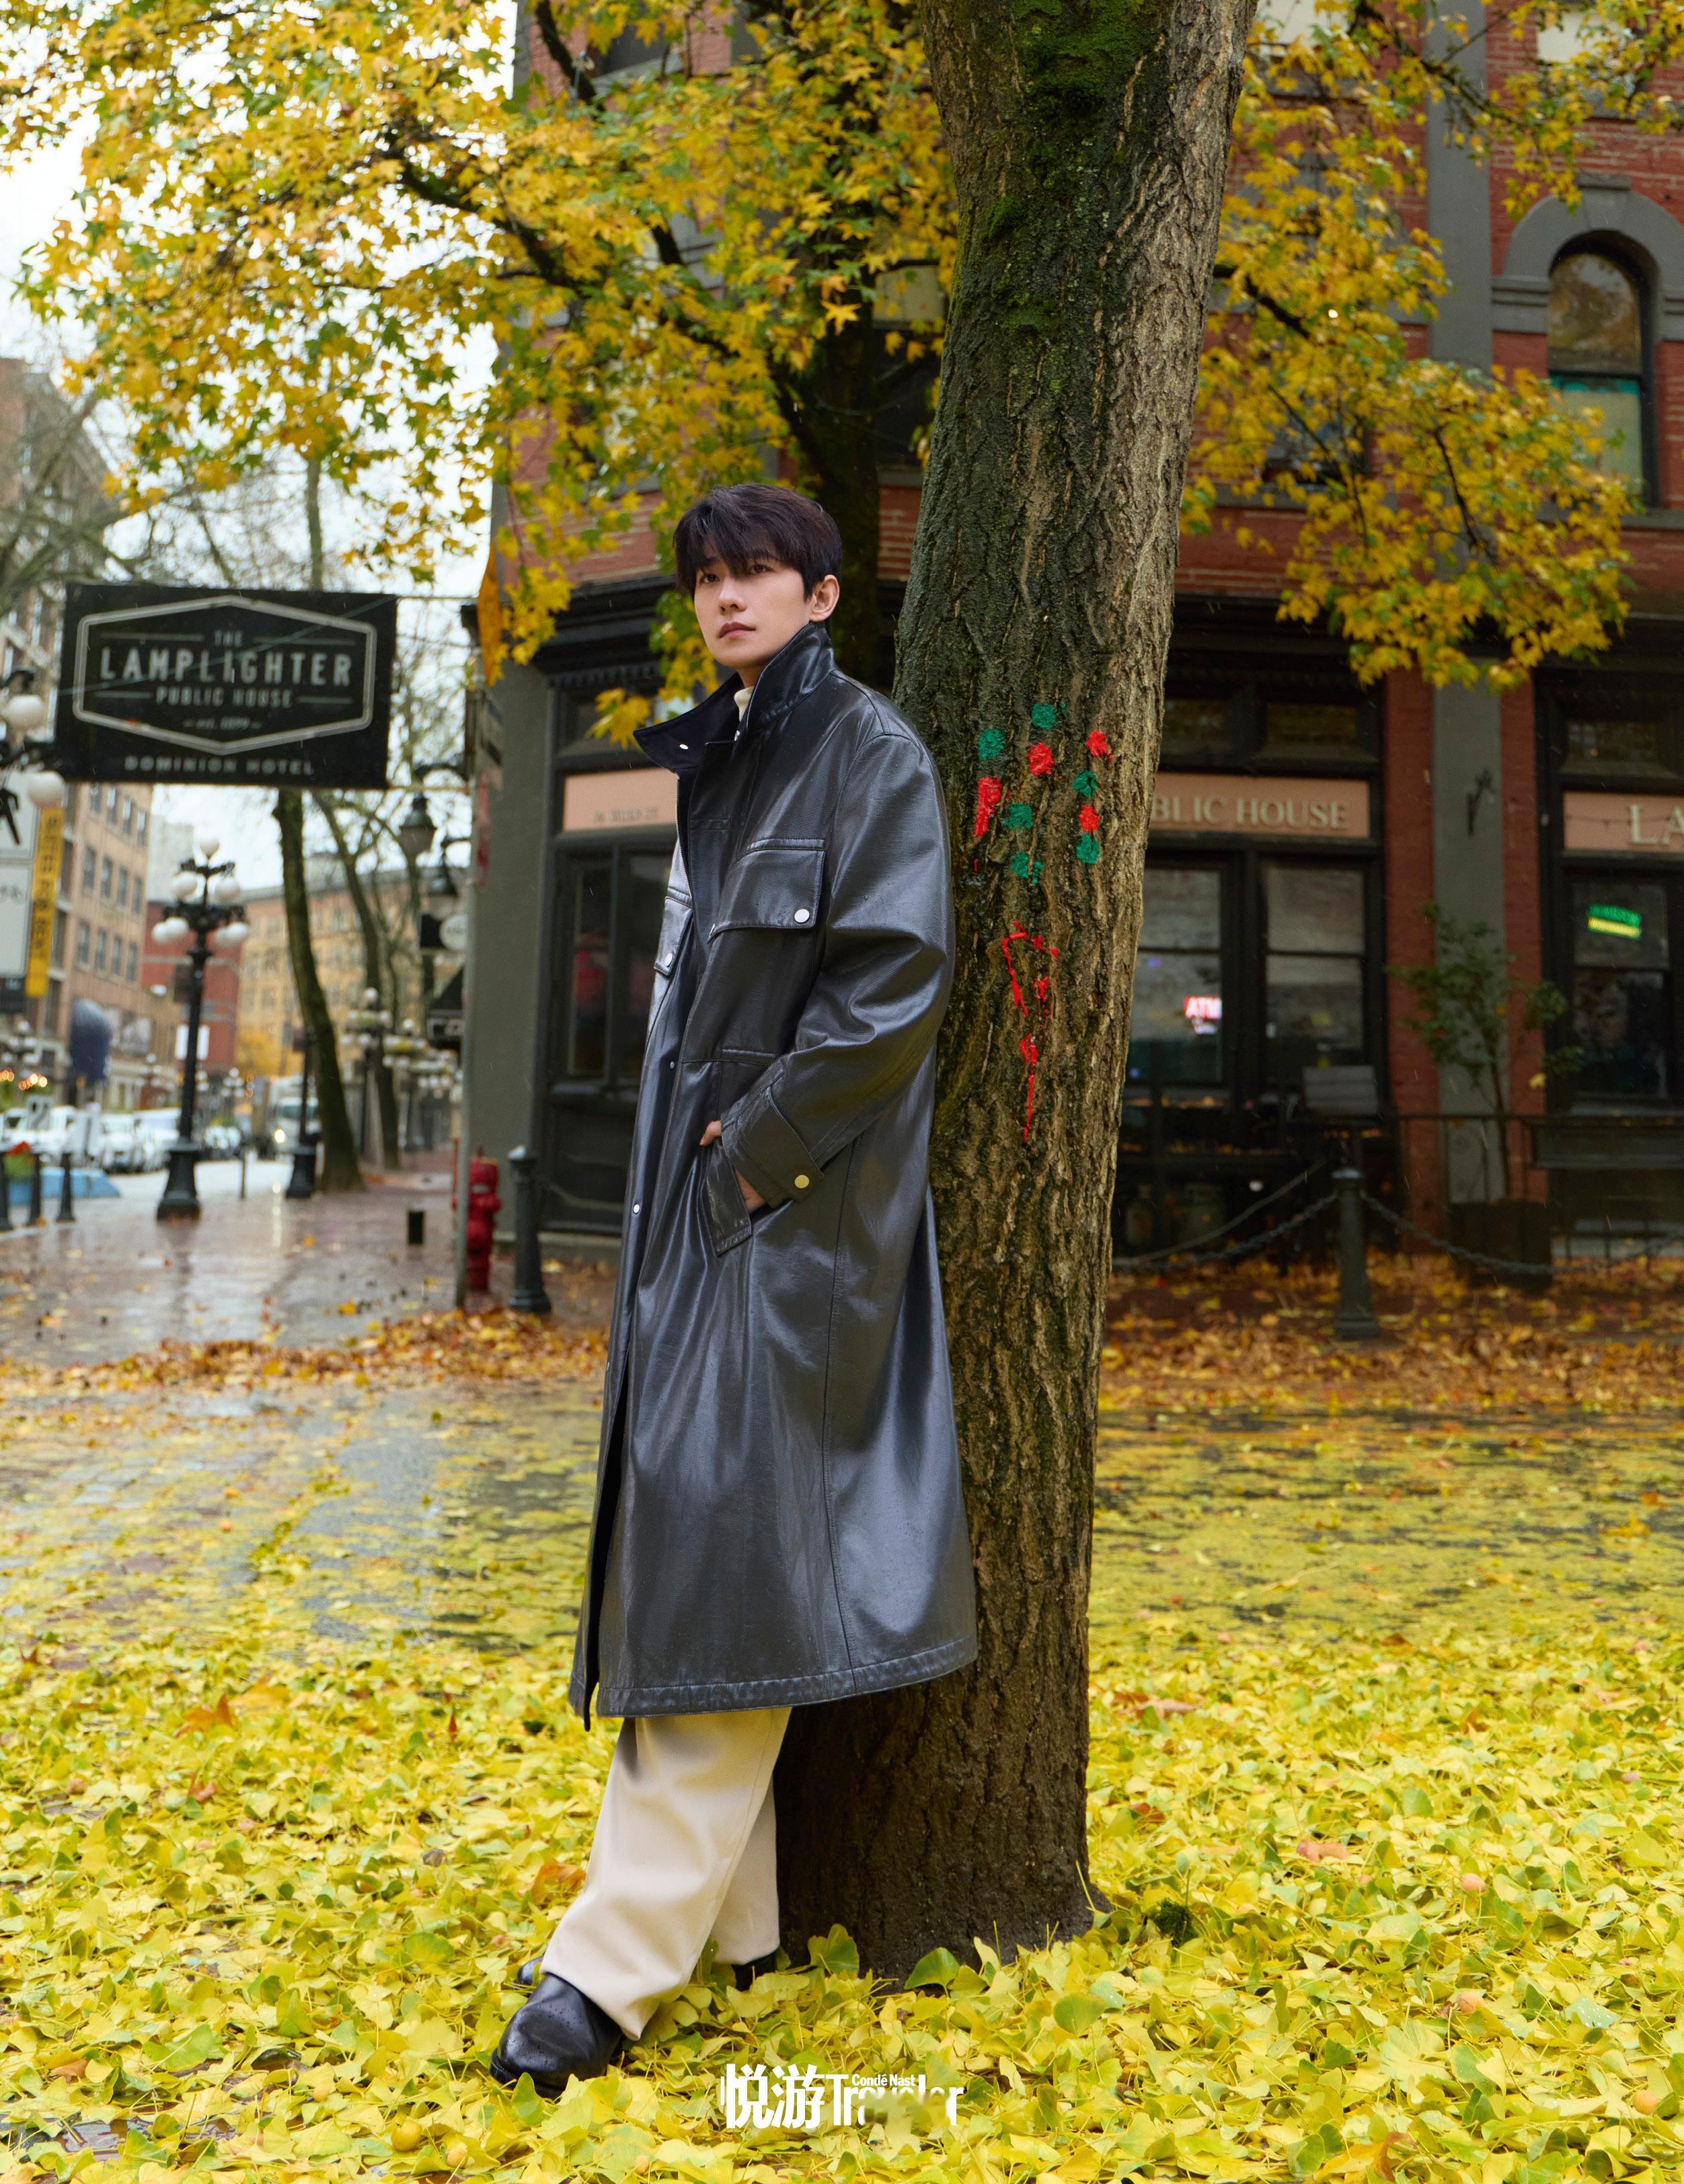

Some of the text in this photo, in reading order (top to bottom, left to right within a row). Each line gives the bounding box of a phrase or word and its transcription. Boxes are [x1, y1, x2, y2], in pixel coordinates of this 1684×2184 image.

[214, 630, 243, 648] THE
[100, 647, 353, 687] LAMPLIGHTER
[155, 685, 293, 709] PUBLIC HOUSE
[124, 754, 315, 776] DOMINION HOTEL
[1236, 797, 1348, 830] HOUSE
